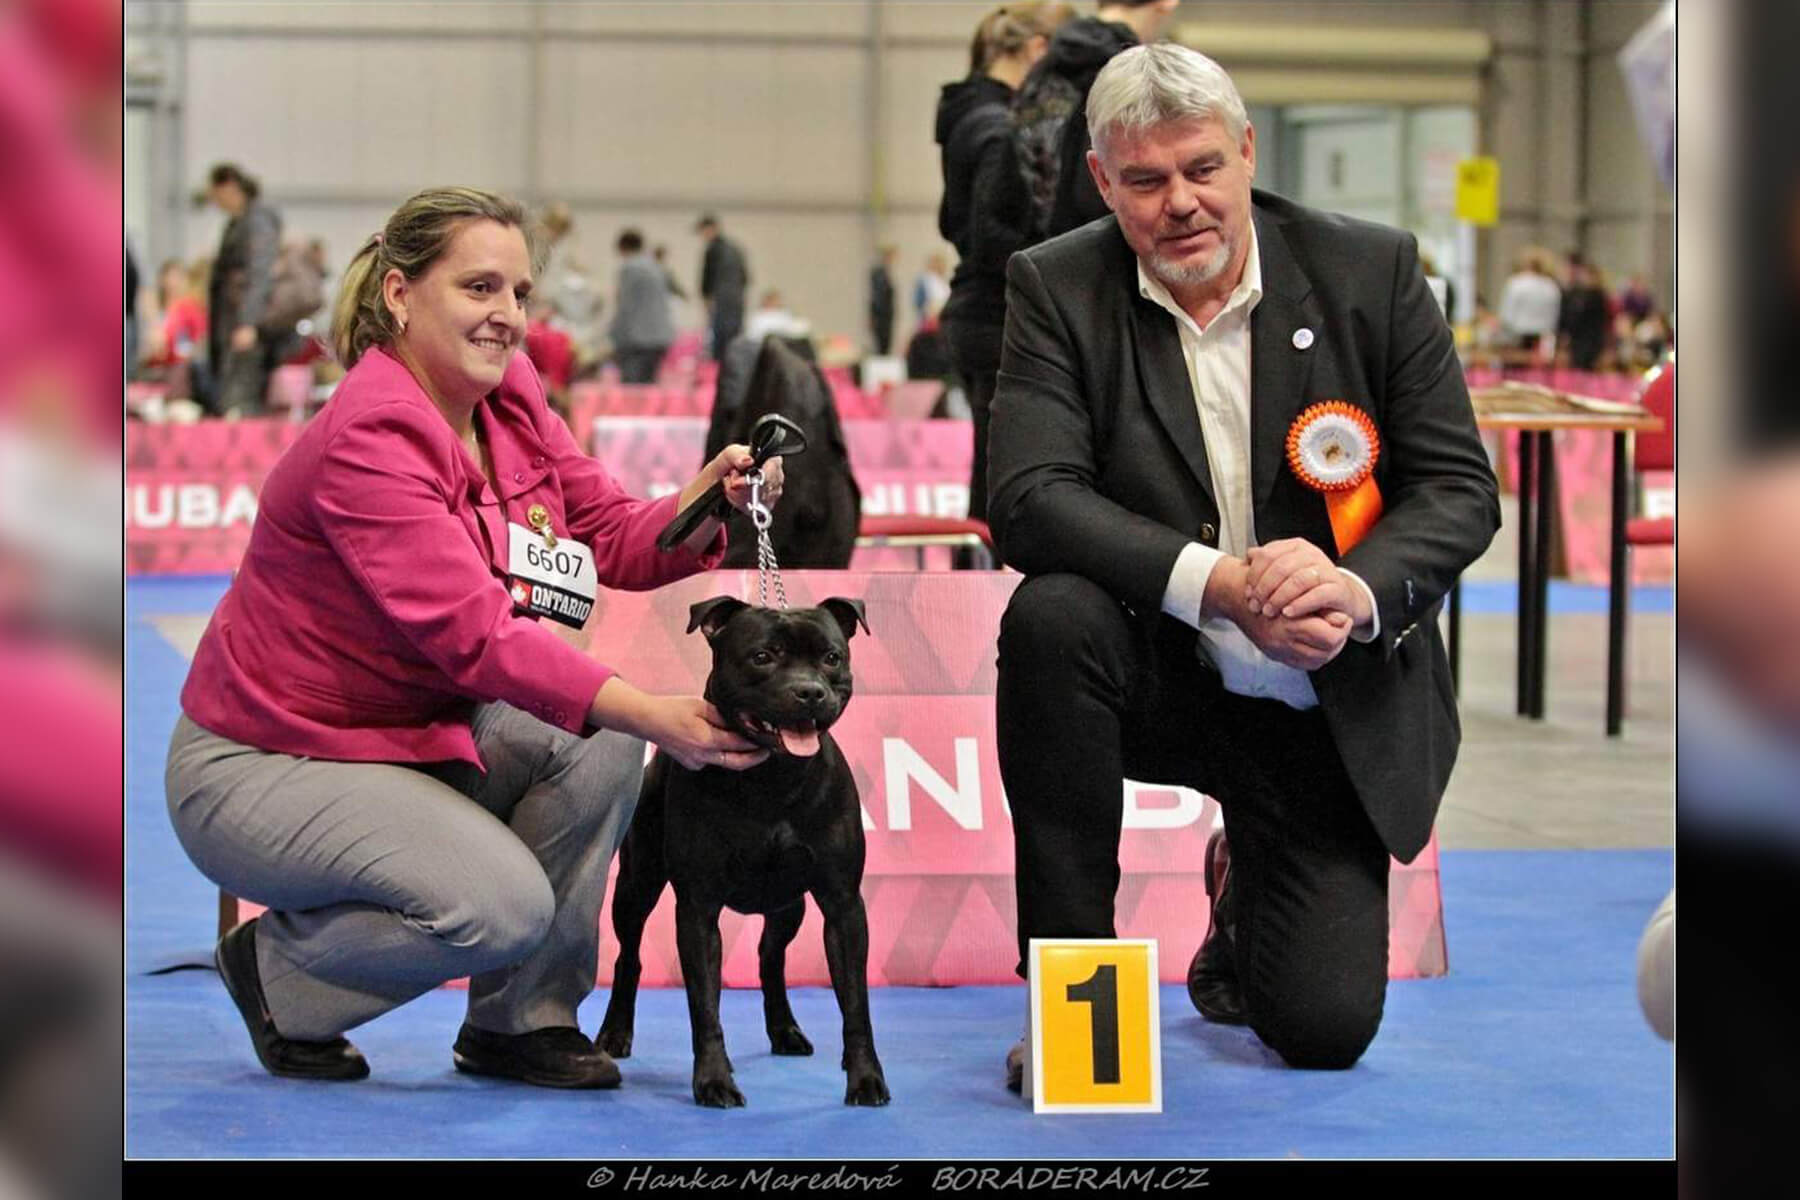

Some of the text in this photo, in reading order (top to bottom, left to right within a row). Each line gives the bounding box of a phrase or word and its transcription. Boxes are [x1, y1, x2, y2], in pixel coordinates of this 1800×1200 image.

[527, 543, 583, 579] 6607
[531, 585, 591, 620] ONTARIO
[1066, 965, 1120, 1083] 1
